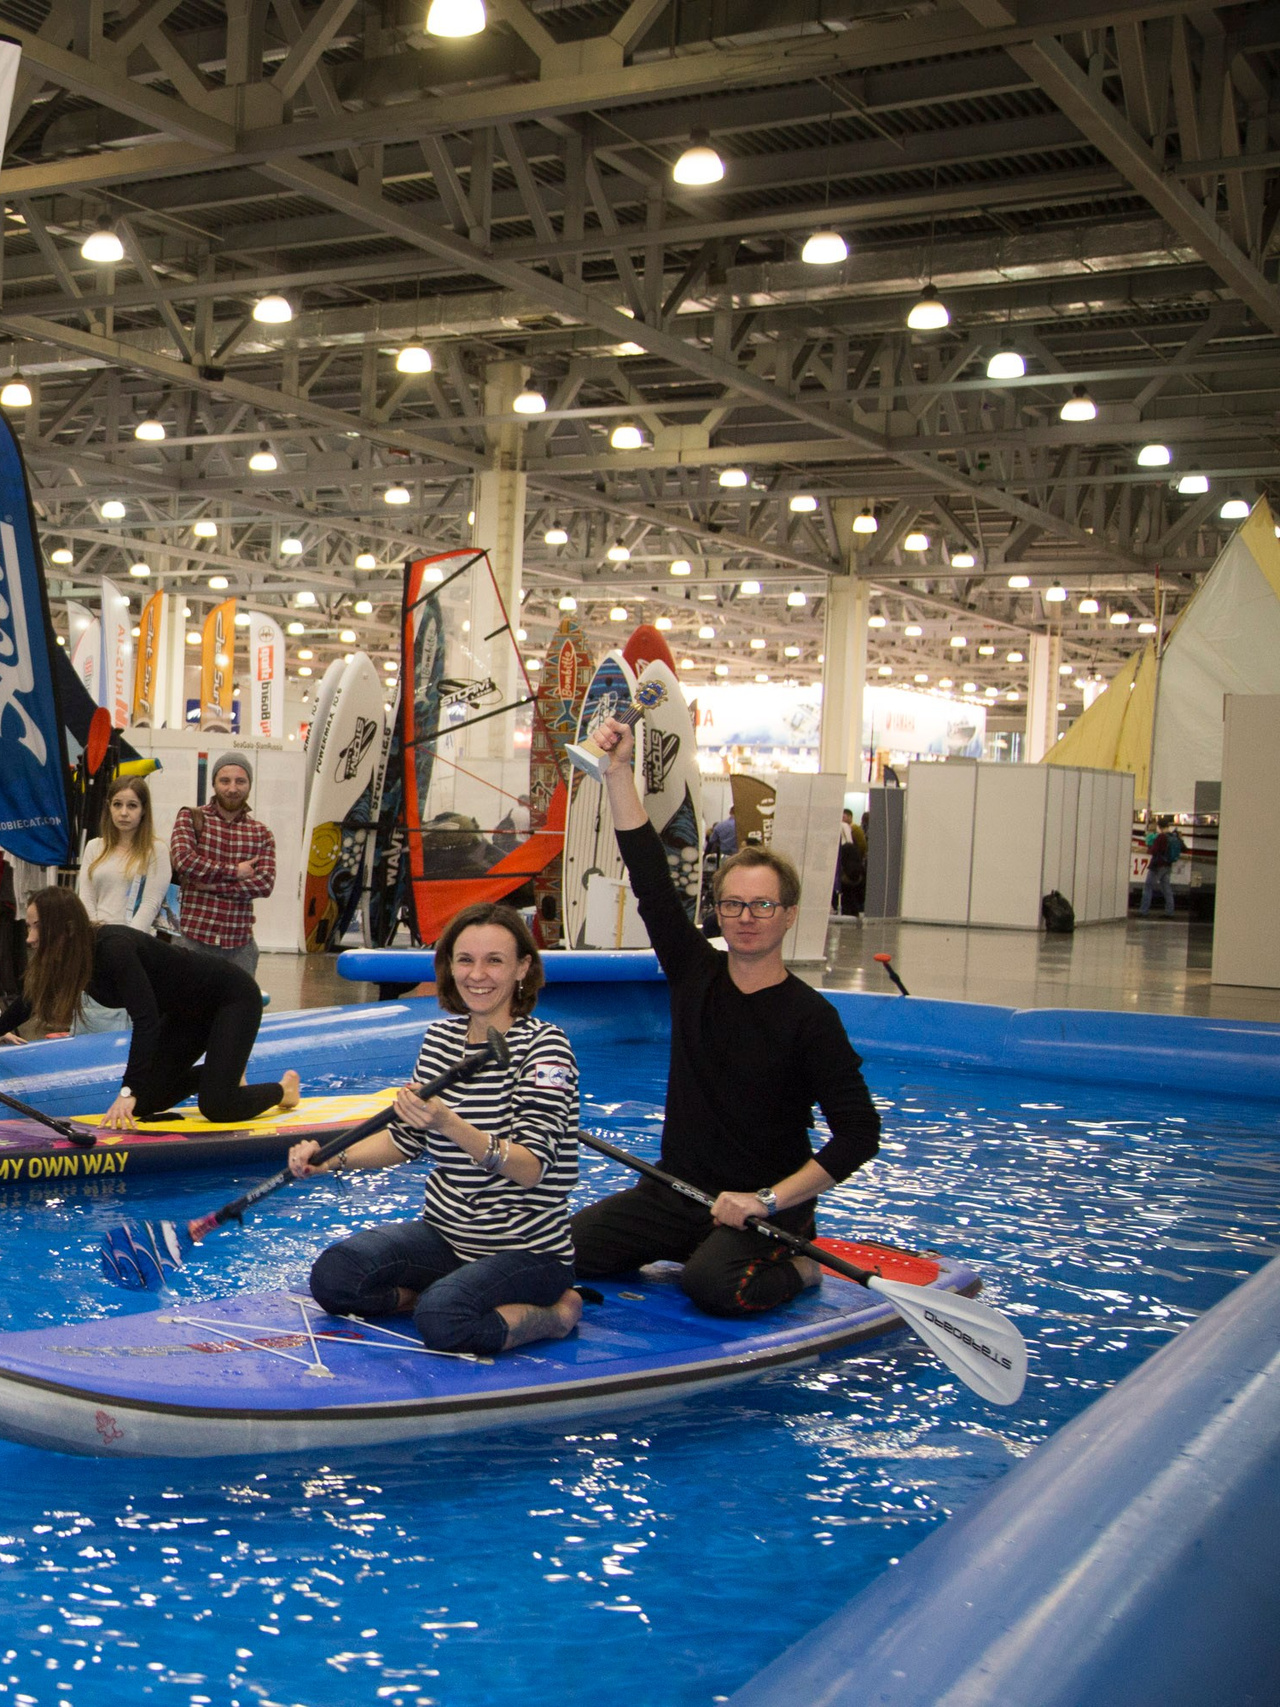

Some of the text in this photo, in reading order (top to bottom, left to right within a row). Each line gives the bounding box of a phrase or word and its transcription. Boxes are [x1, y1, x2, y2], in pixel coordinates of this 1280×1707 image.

[214, 611, 227, 667] Je
[28, 1155, 79, 1179] OWN
[81, 1152, 129, 1176] WAY
